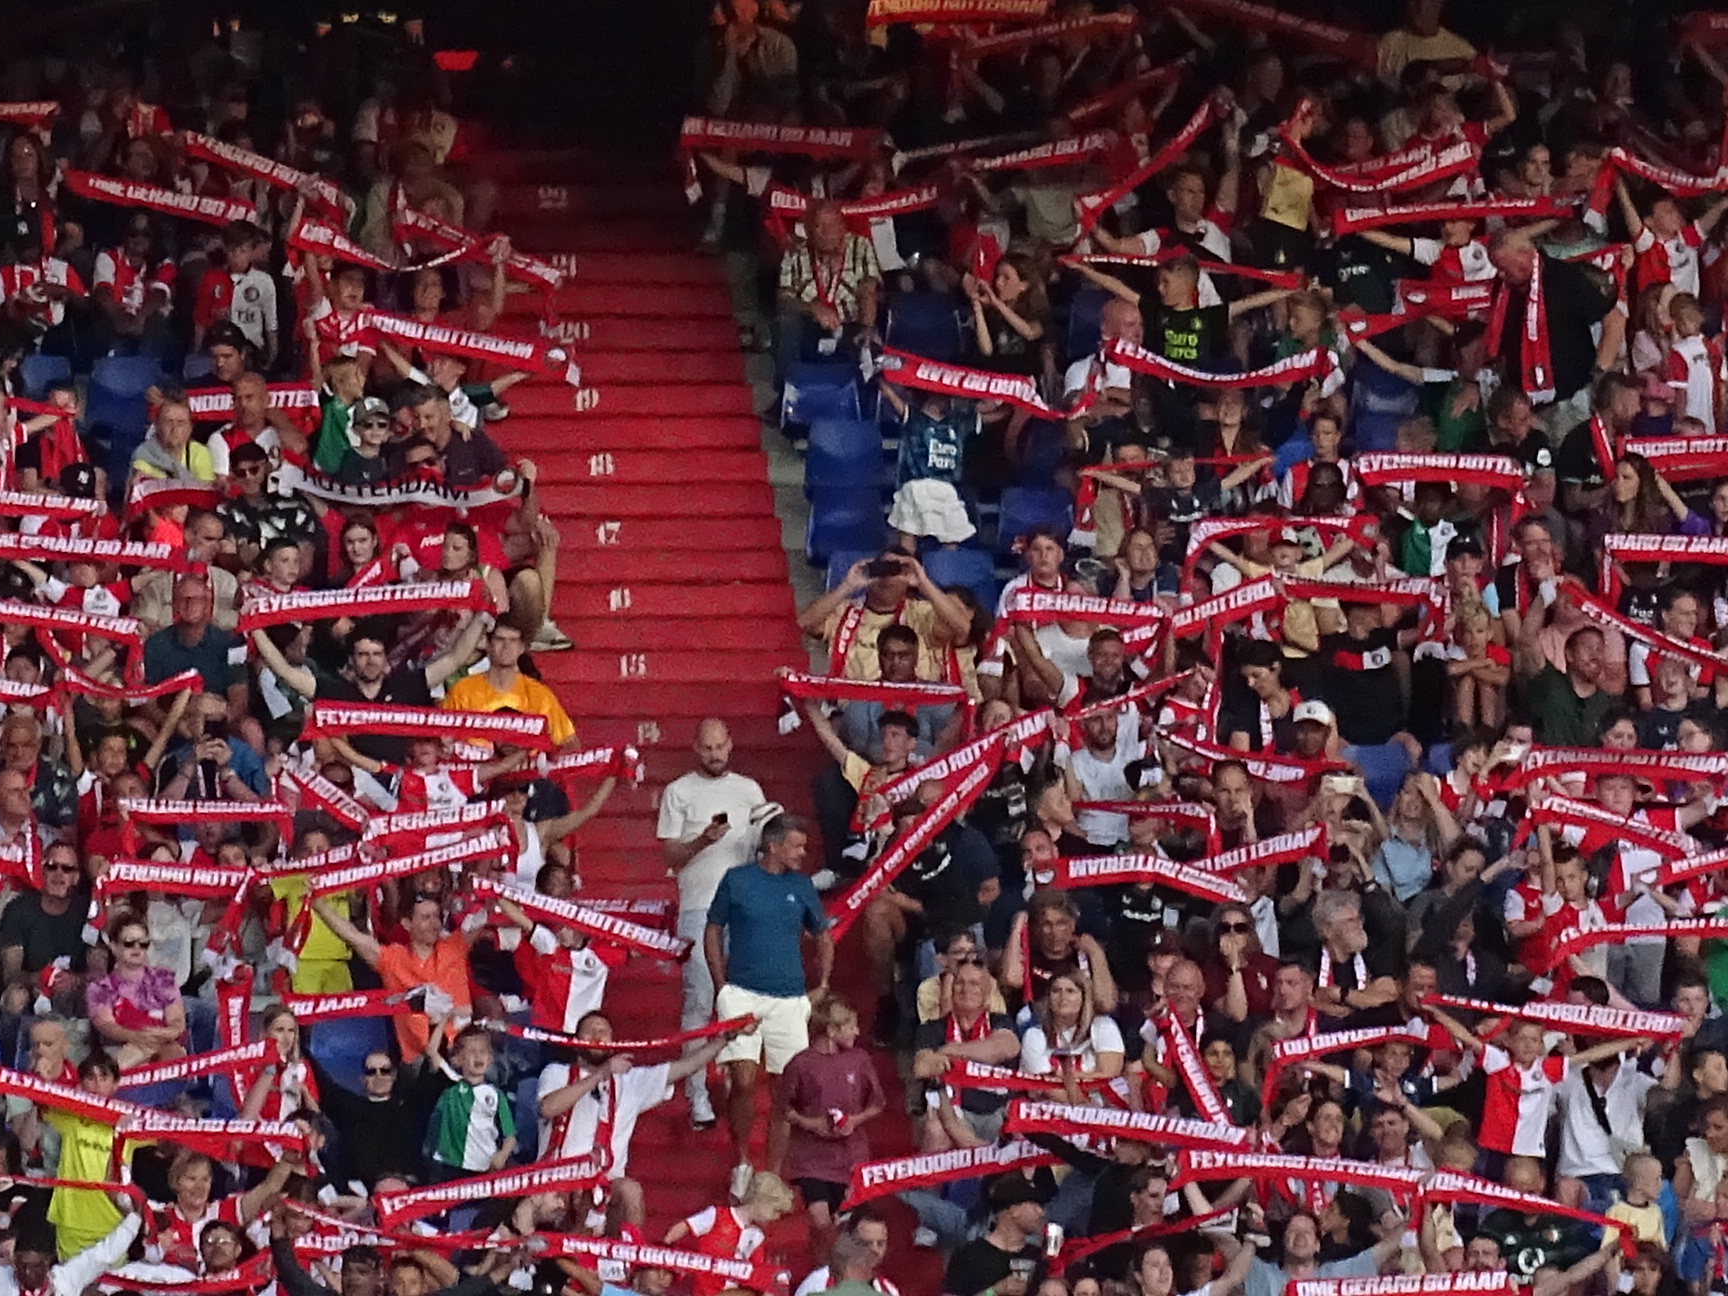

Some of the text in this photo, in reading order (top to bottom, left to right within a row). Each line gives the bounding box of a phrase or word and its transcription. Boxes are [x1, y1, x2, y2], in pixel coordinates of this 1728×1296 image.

[303, 469, 473, 503] ROTTERDAM
[595, 521, 622, 545] 17
[315, 995, 369, 1014] JAAR
[863, 1149, 974, 1187] FEYENOORD
[1295, 1270, 1508, 1296] OME GERARD 90 JAAR
